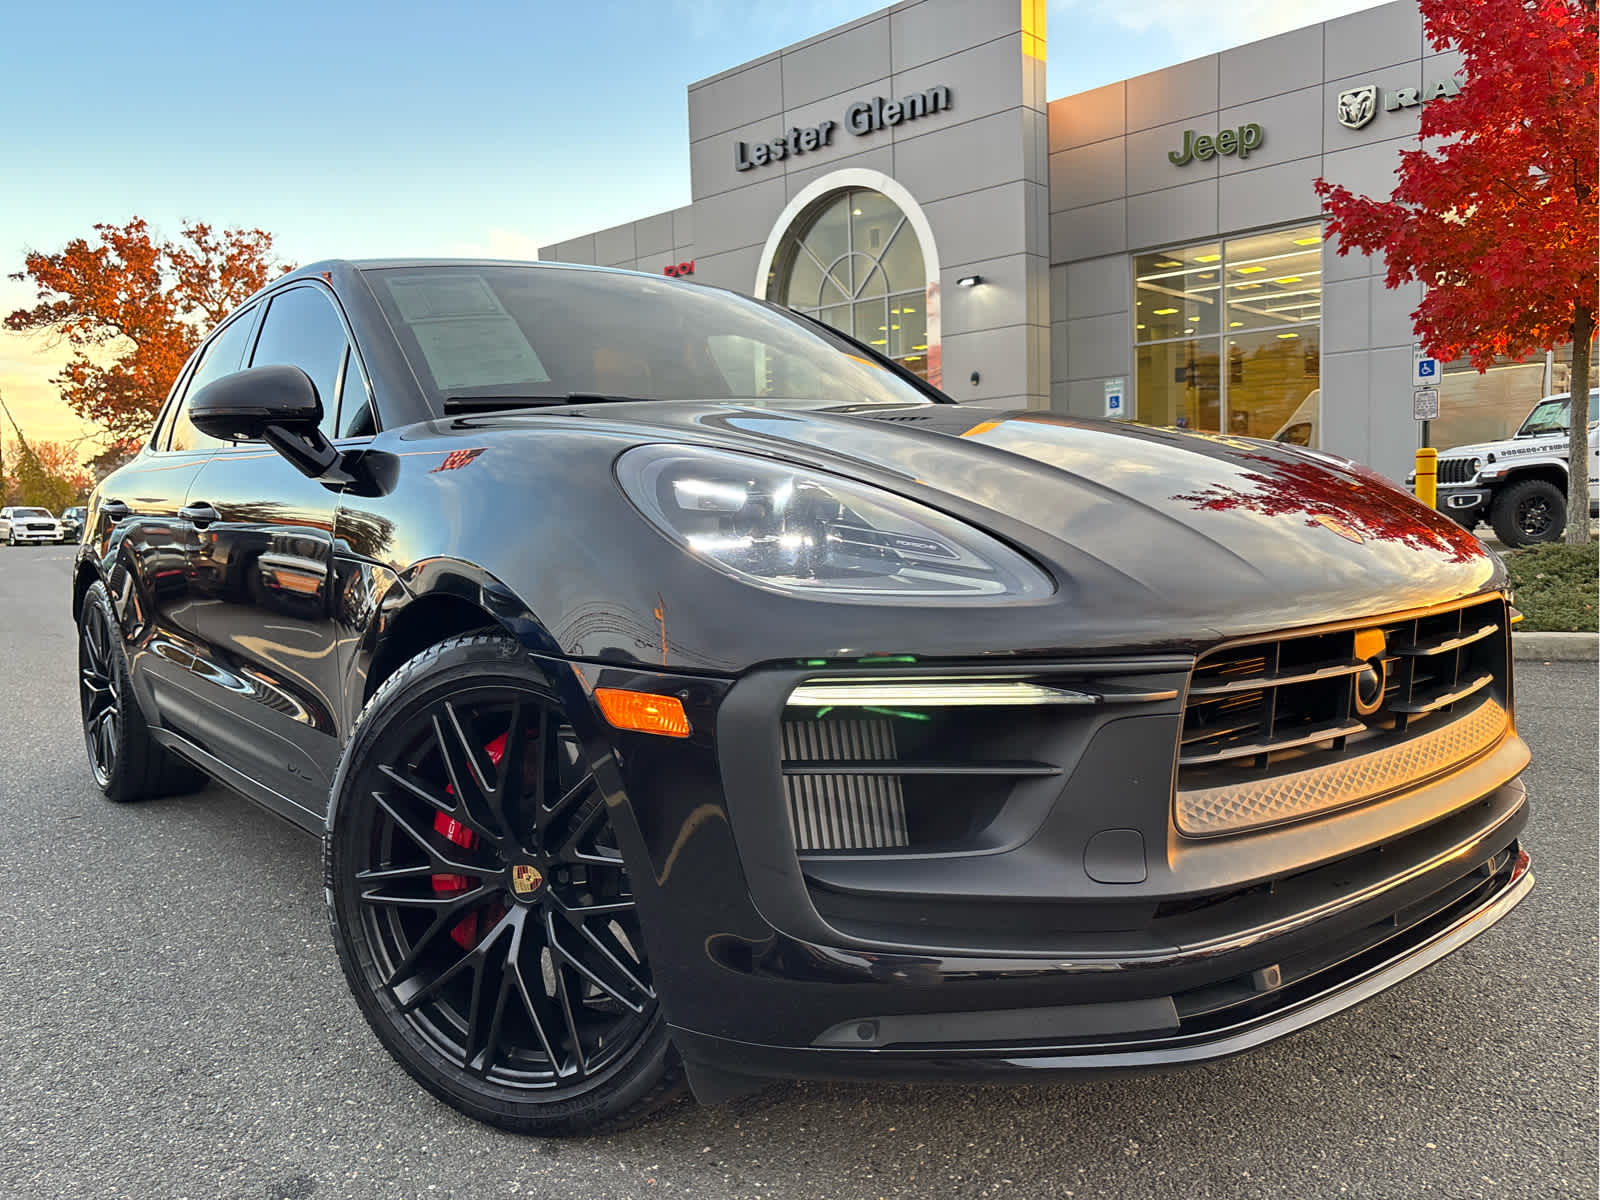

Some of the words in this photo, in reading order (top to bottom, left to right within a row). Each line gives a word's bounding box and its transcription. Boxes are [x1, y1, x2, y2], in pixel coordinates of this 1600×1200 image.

[1384, 76, 1466, 111] RA
[734, 119, 835, 172] Lester
[844, 84, 953, 136] Glenn
[1167, 121, 1264, 167] Jeep
